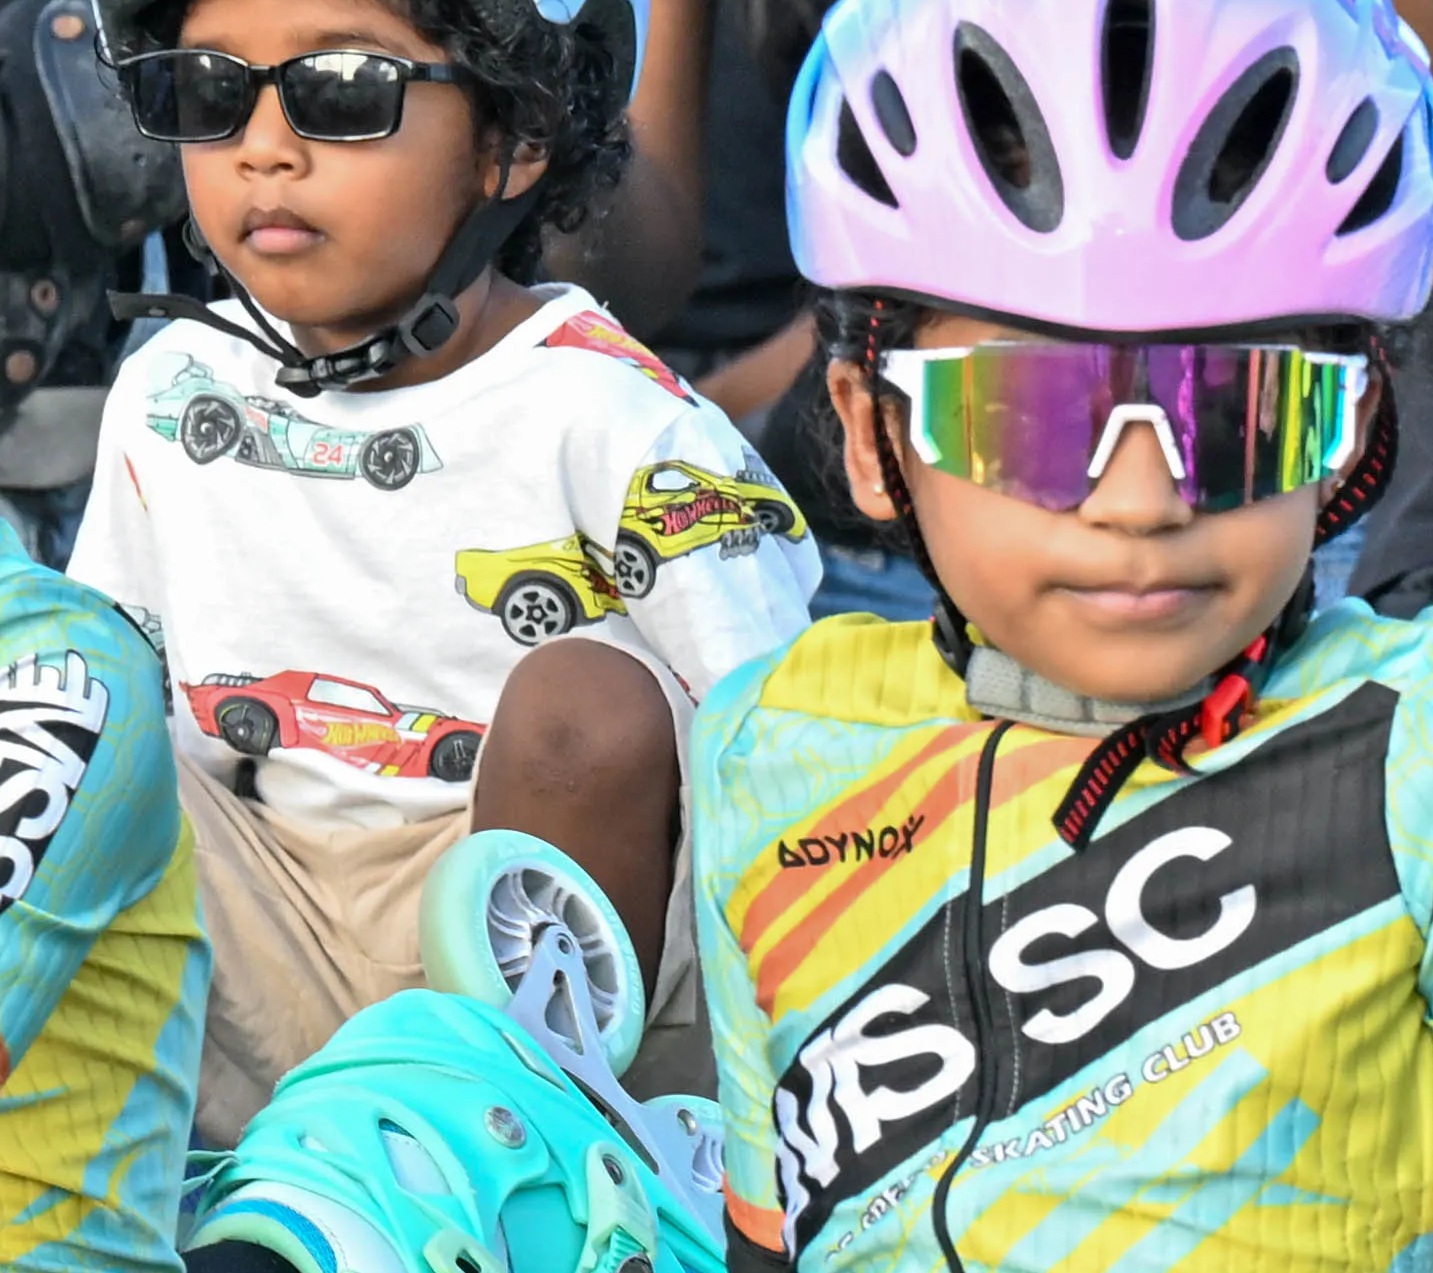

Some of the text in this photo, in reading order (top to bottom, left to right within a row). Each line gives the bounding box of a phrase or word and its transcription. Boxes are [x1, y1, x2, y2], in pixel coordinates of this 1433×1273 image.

[313, 443, 343, 465] 24
[969, 1072, 1135, 1169] SKATING
[1140, 1011, 1243, 1084] CLUB
